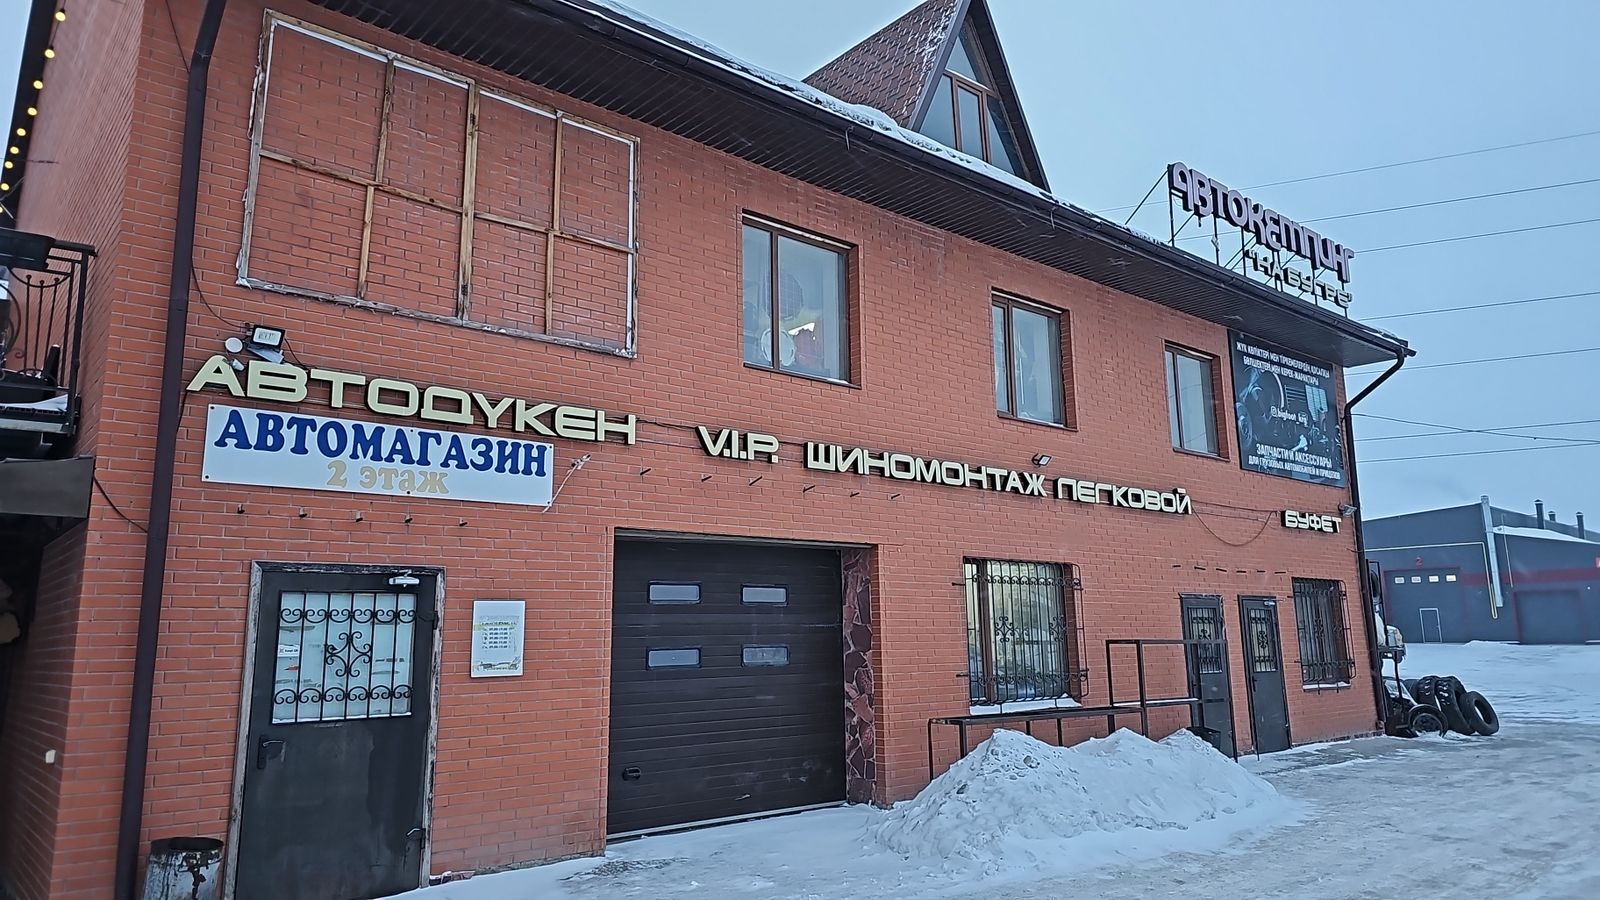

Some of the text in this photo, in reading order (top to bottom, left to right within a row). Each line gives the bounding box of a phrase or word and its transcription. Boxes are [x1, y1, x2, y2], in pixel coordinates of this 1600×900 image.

[1169, 162, 1354, 283] АВТОКЕМПИНГ
[214, 409, 547, 477] АВТОМАГАЗИН
[1256, 444, 1289, 460] ЗАПЧАСТИ
[1295, 452, 1332, 468] АКСЕССУАРЫ
[327, 460, 450, 494] 2 этаж
[806, 441, 1047, 497] ШИНОМОНТАЖ
[1284, 510, 1342, 533] БУФЕТ
